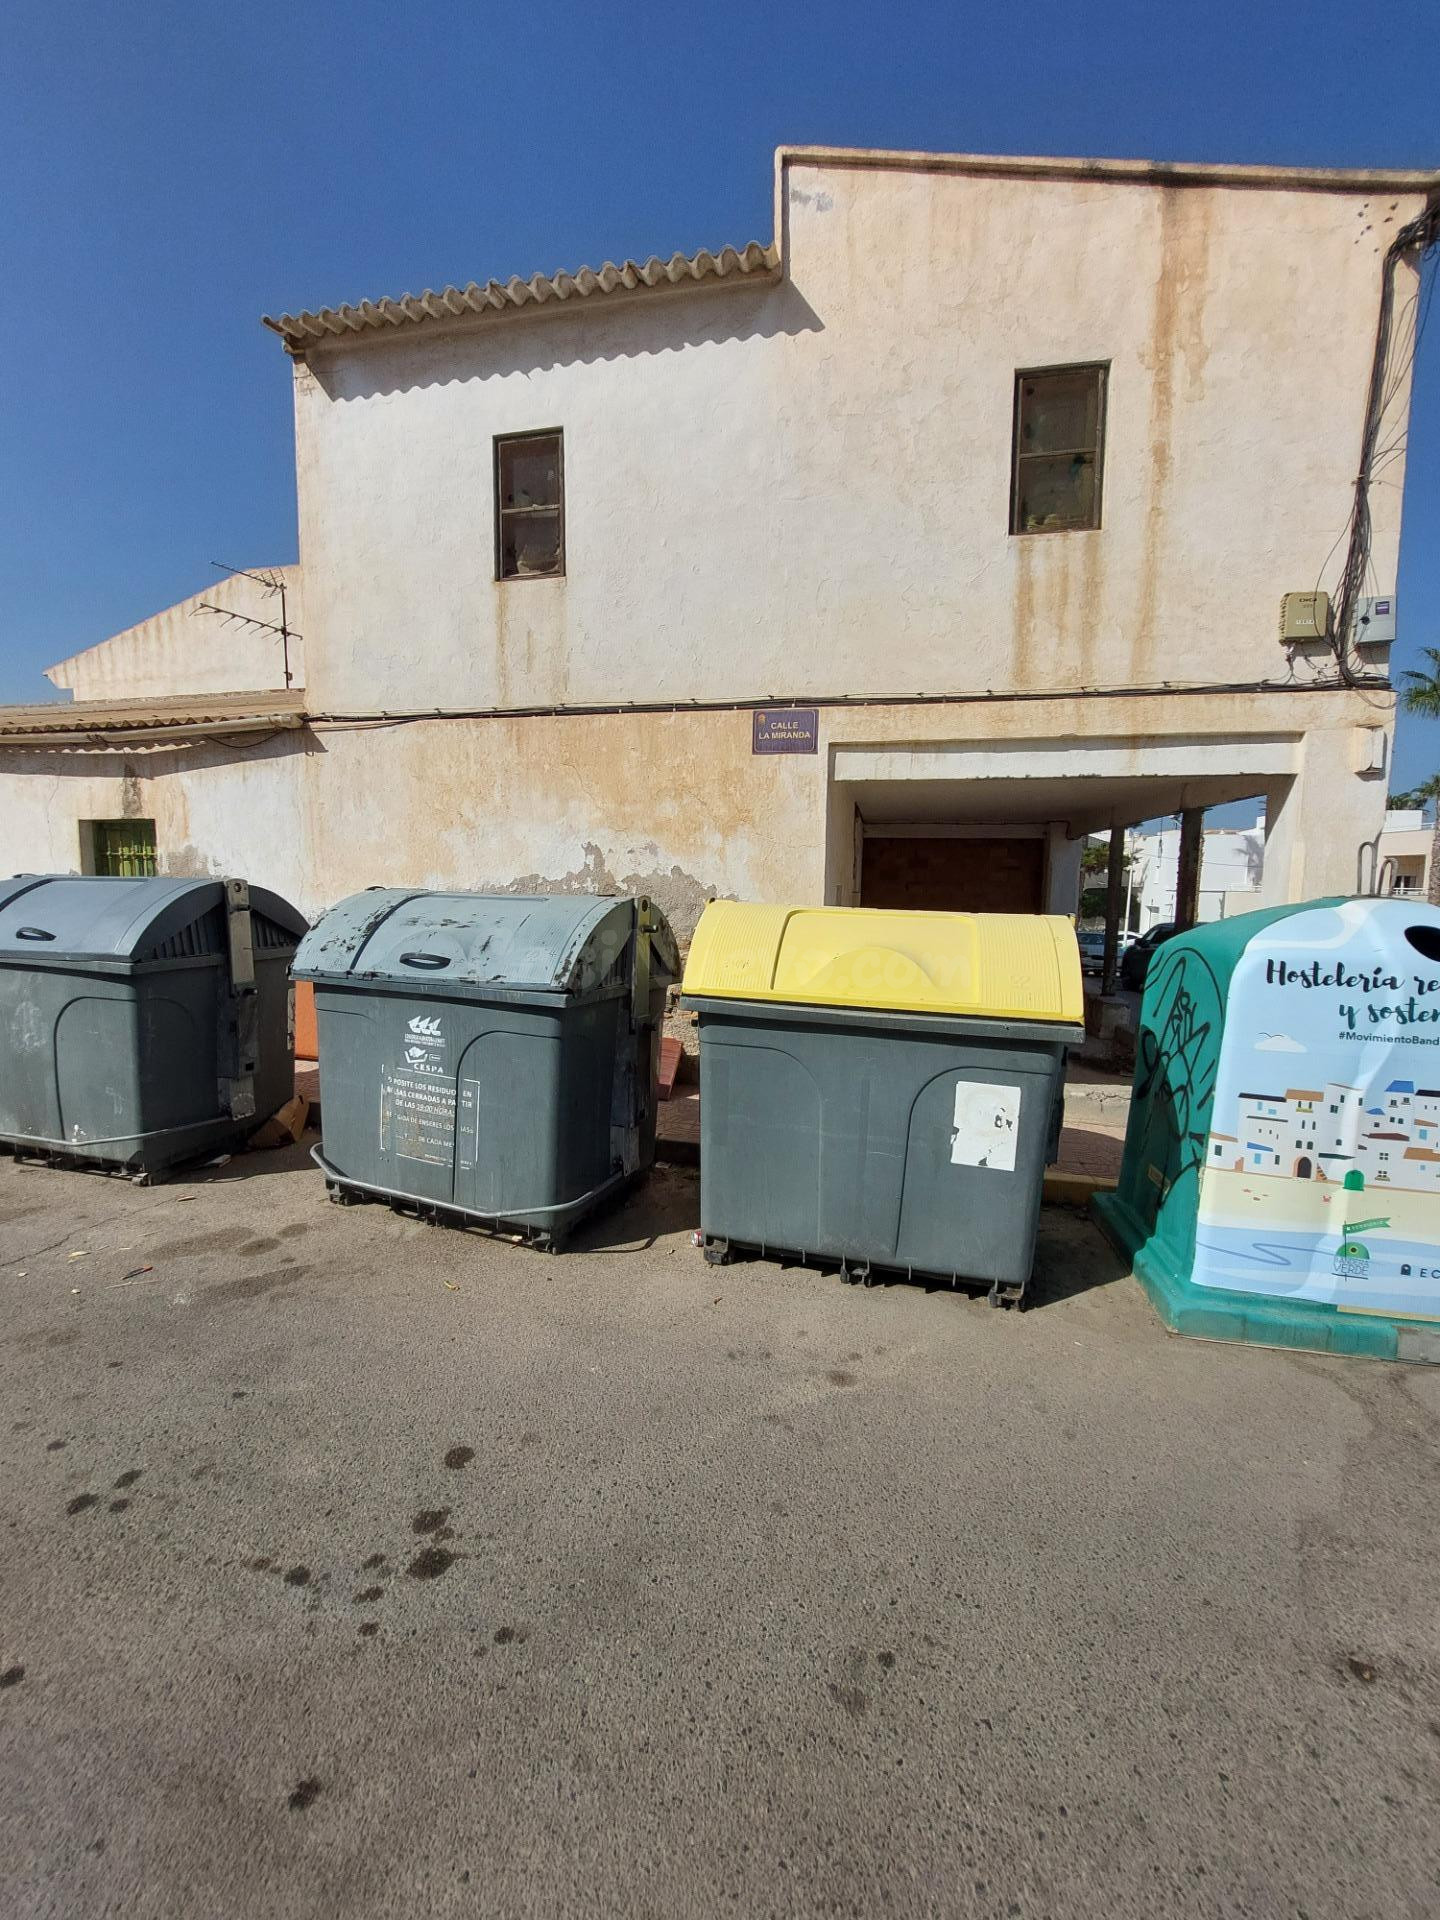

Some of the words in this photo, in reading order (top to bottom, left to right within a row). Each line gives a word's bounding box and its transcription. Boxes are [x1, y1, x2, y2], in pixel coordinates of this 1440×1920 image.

[770, 721, 799, 730] CALLE
[758, 732, 770, 740] LA
[771, 731, 811, 740] MIRANDA
[1266, 958, 1406, 993] Hostelería
[1338, 1004, 1361, 1030] y
[414, 1063, 444, 1073] CESPA
